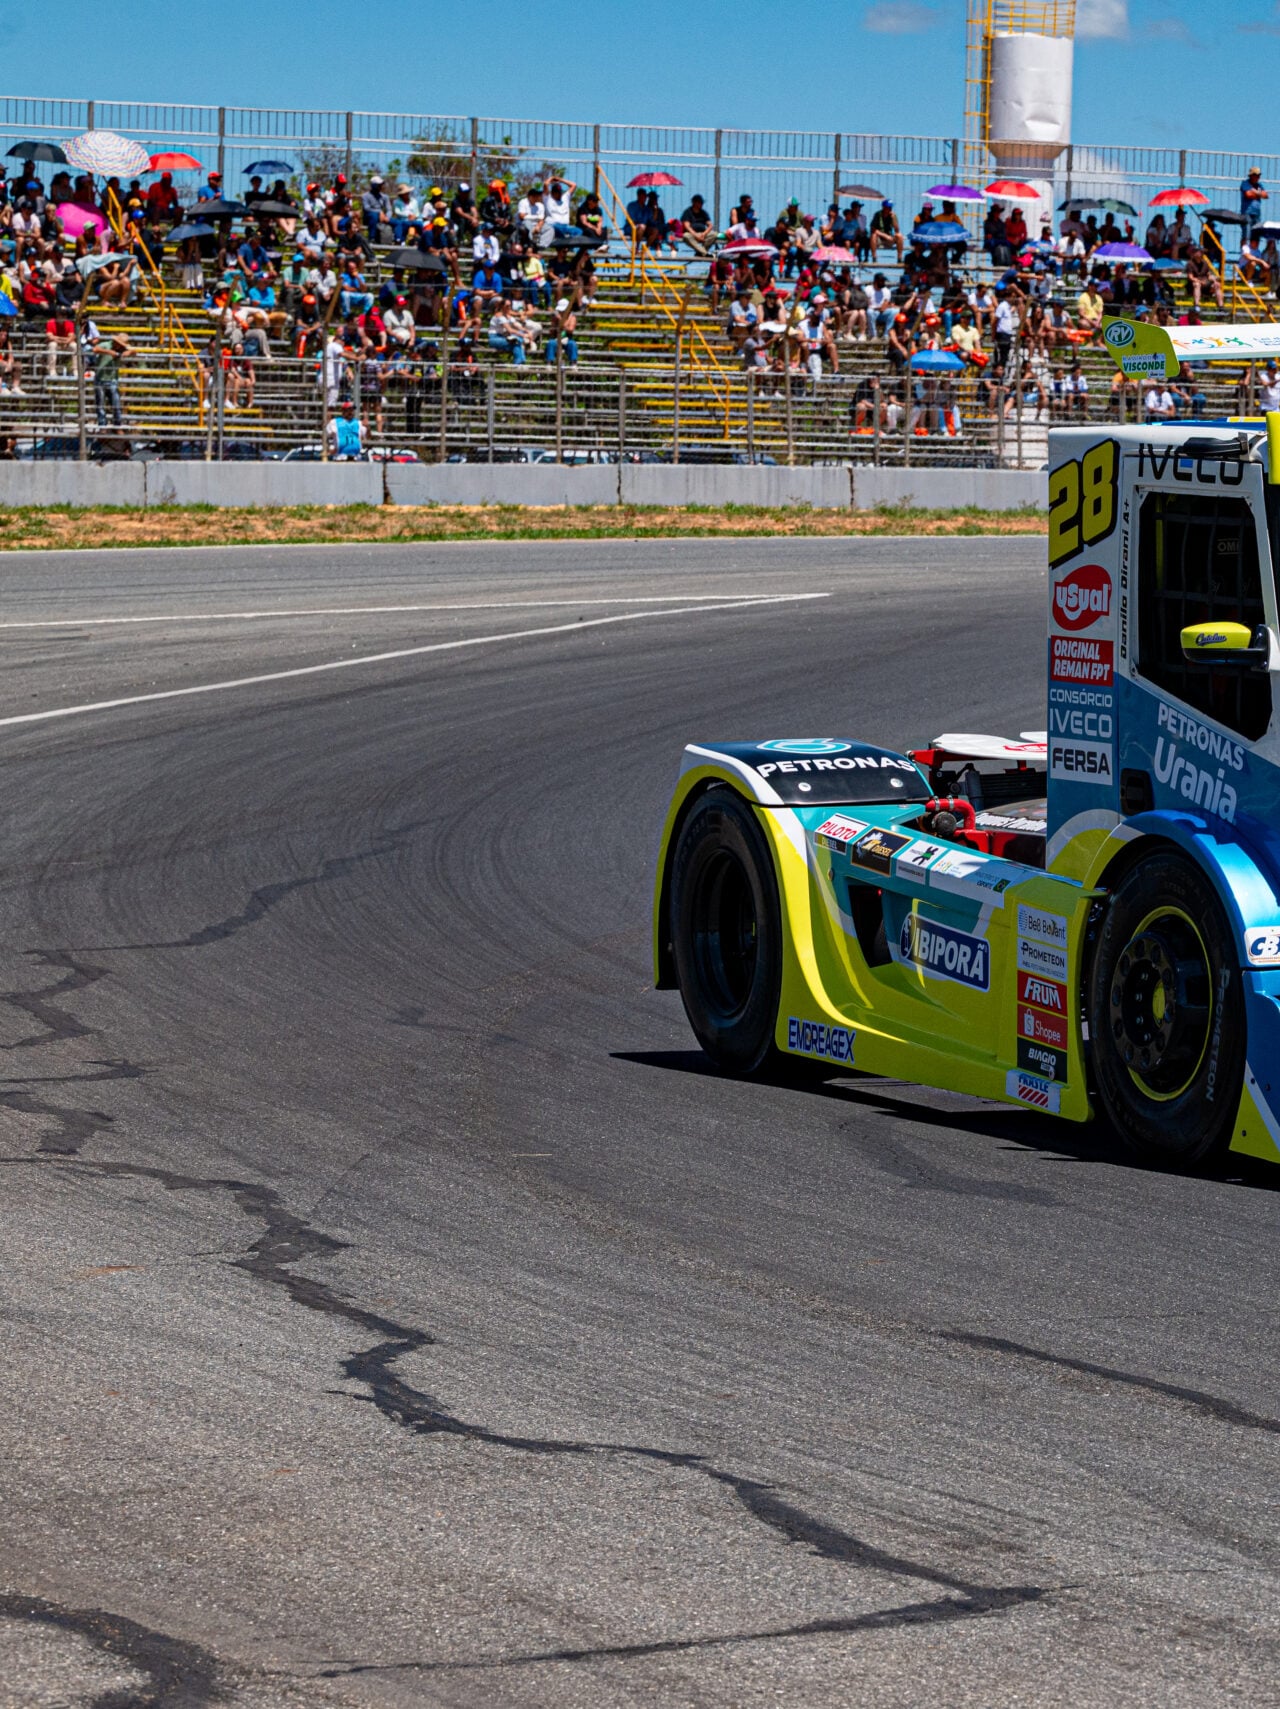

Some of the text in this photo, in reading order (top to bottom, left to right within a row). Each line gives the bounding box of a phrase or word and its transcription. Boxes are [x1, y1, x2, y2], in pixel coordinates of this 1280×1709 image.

[1122, 360, 1165, 372] VISCONDE
[1048, 440, 1117, 567] 28
[1054, 639, 1101, 660] ORIGINAL
[1053, 659, 1111, 681] REMAN FPT
[1049, 688, 1113, 708] CONSÓRCIO
[1049, 708, 1113, 738] IVECO
[1157, 702, 1244, 771] PETRONAS
[756, 757, 917, 778] PETRONAS
[1052, 748, 1111, 775] FERSA
[1154, 737, 1237, 823] Urania
[817, 821, 857, 840] PILOTO
[913, 928, 985, 981] IBIPORÃ
[1020, 942, 1065, 967] PROMETEON
[1024, 977, 1062, 1010] FRUM
[1035, 1020, 1061, 1043] Shopee
[1028, 1047, 1057, 1066] BIAGIO
